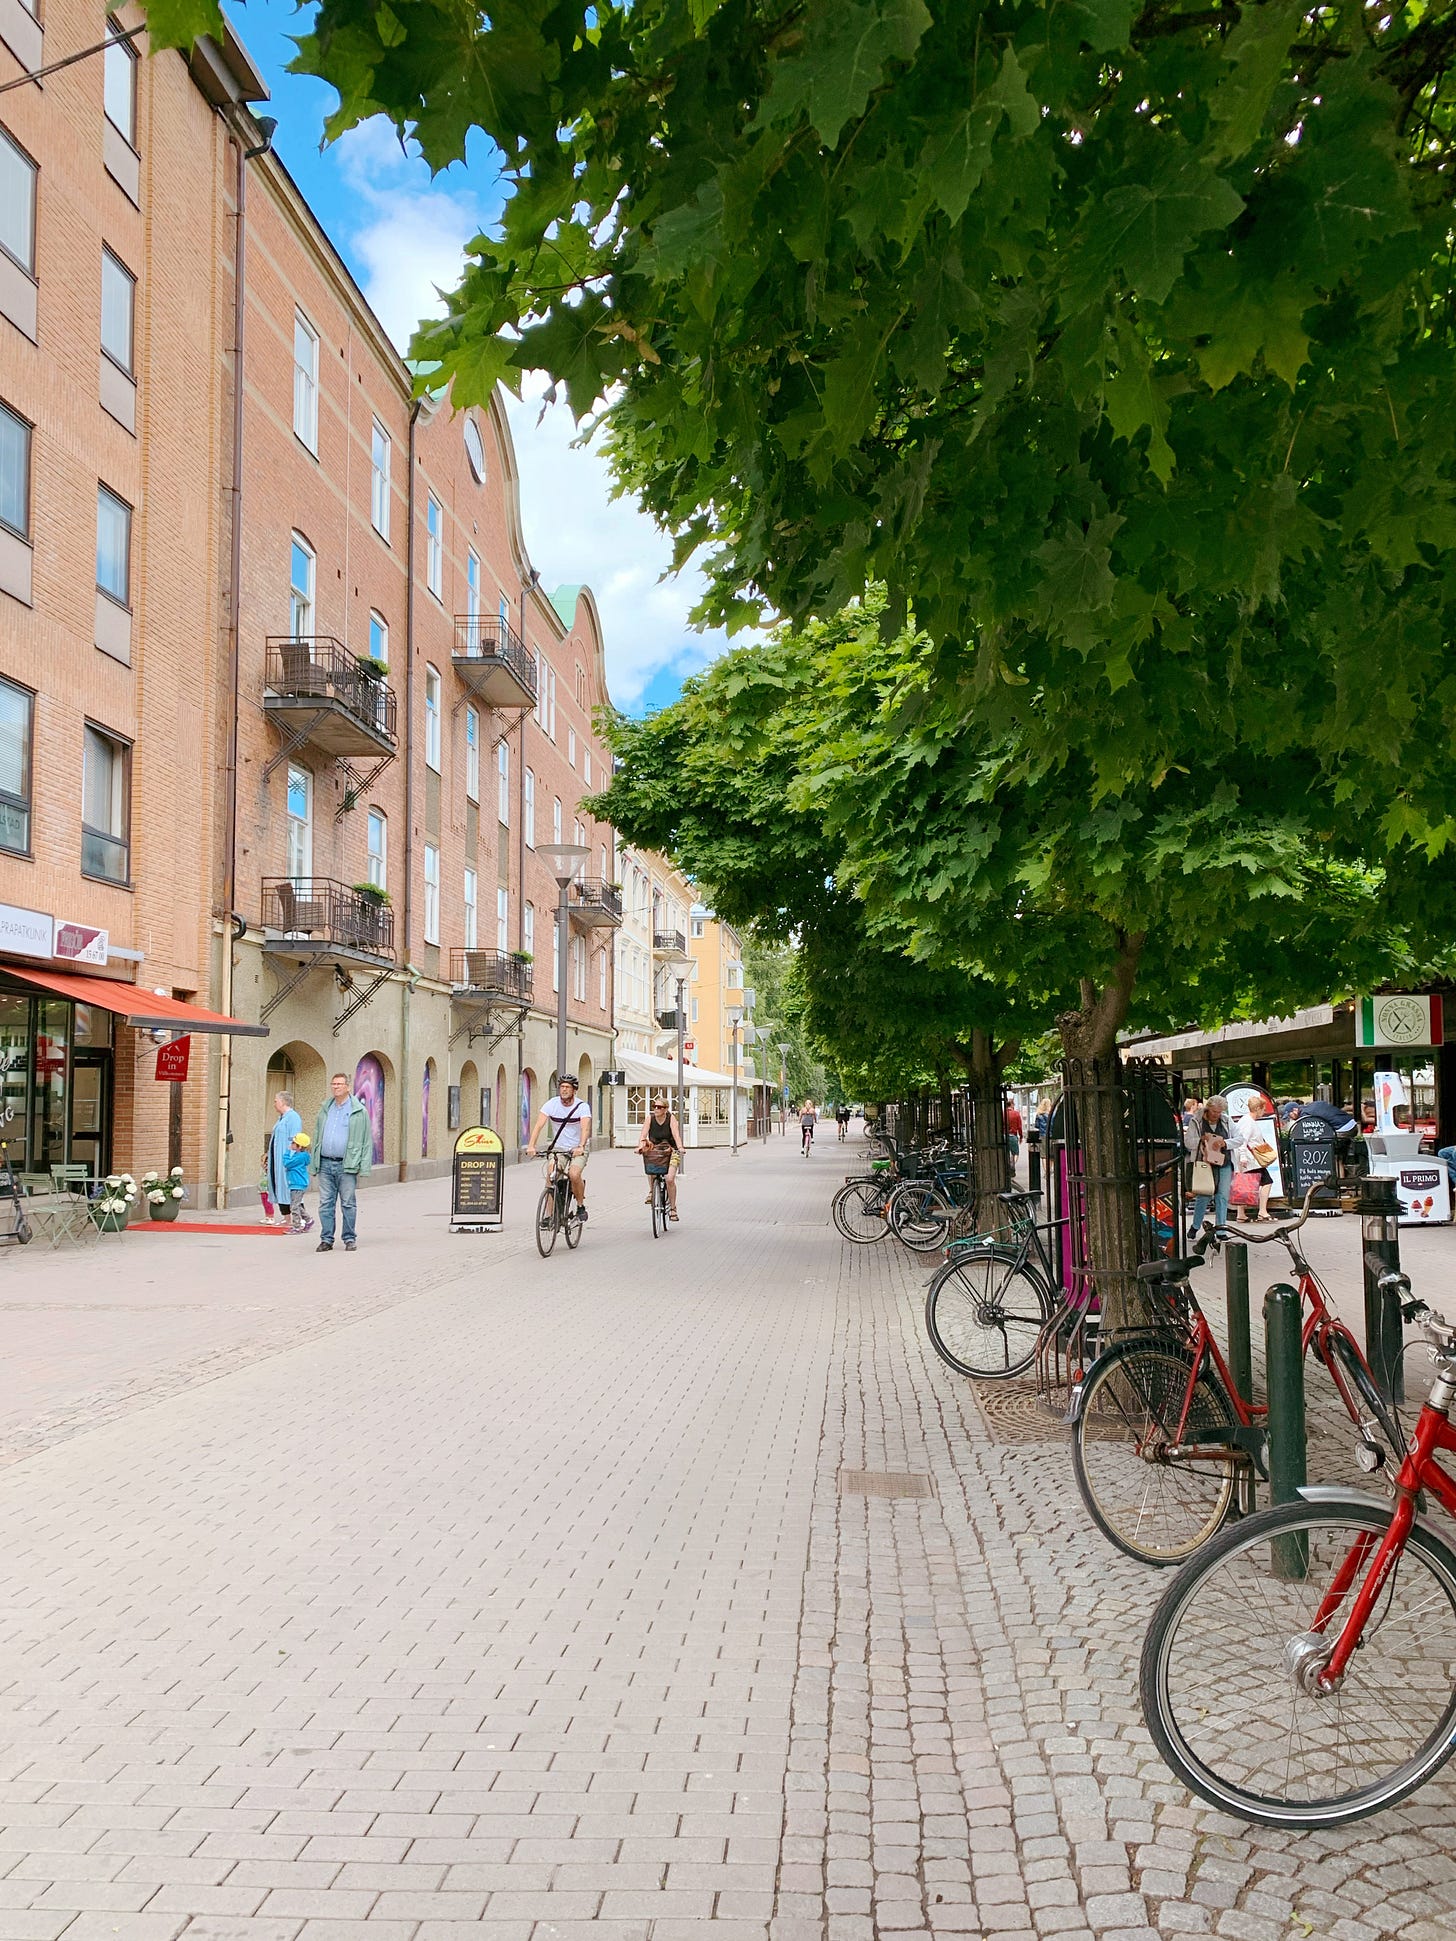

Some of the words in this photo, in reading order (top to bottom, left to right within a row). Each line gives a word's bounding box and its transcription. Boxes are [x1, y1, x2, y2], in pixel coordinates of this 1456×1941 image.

[162, 1053, 185, 1064] Drop
[167, 1062, 177, 1070] in
[1302, 1150, 1328, 1165] 20%
[461, 1161, 484, 1169] DROP
[486, 1161, 496, 1169] IN
[1403, 1175, 1411, 1183] IL
[1412, 1174, 1438, 1183] PRIMO
